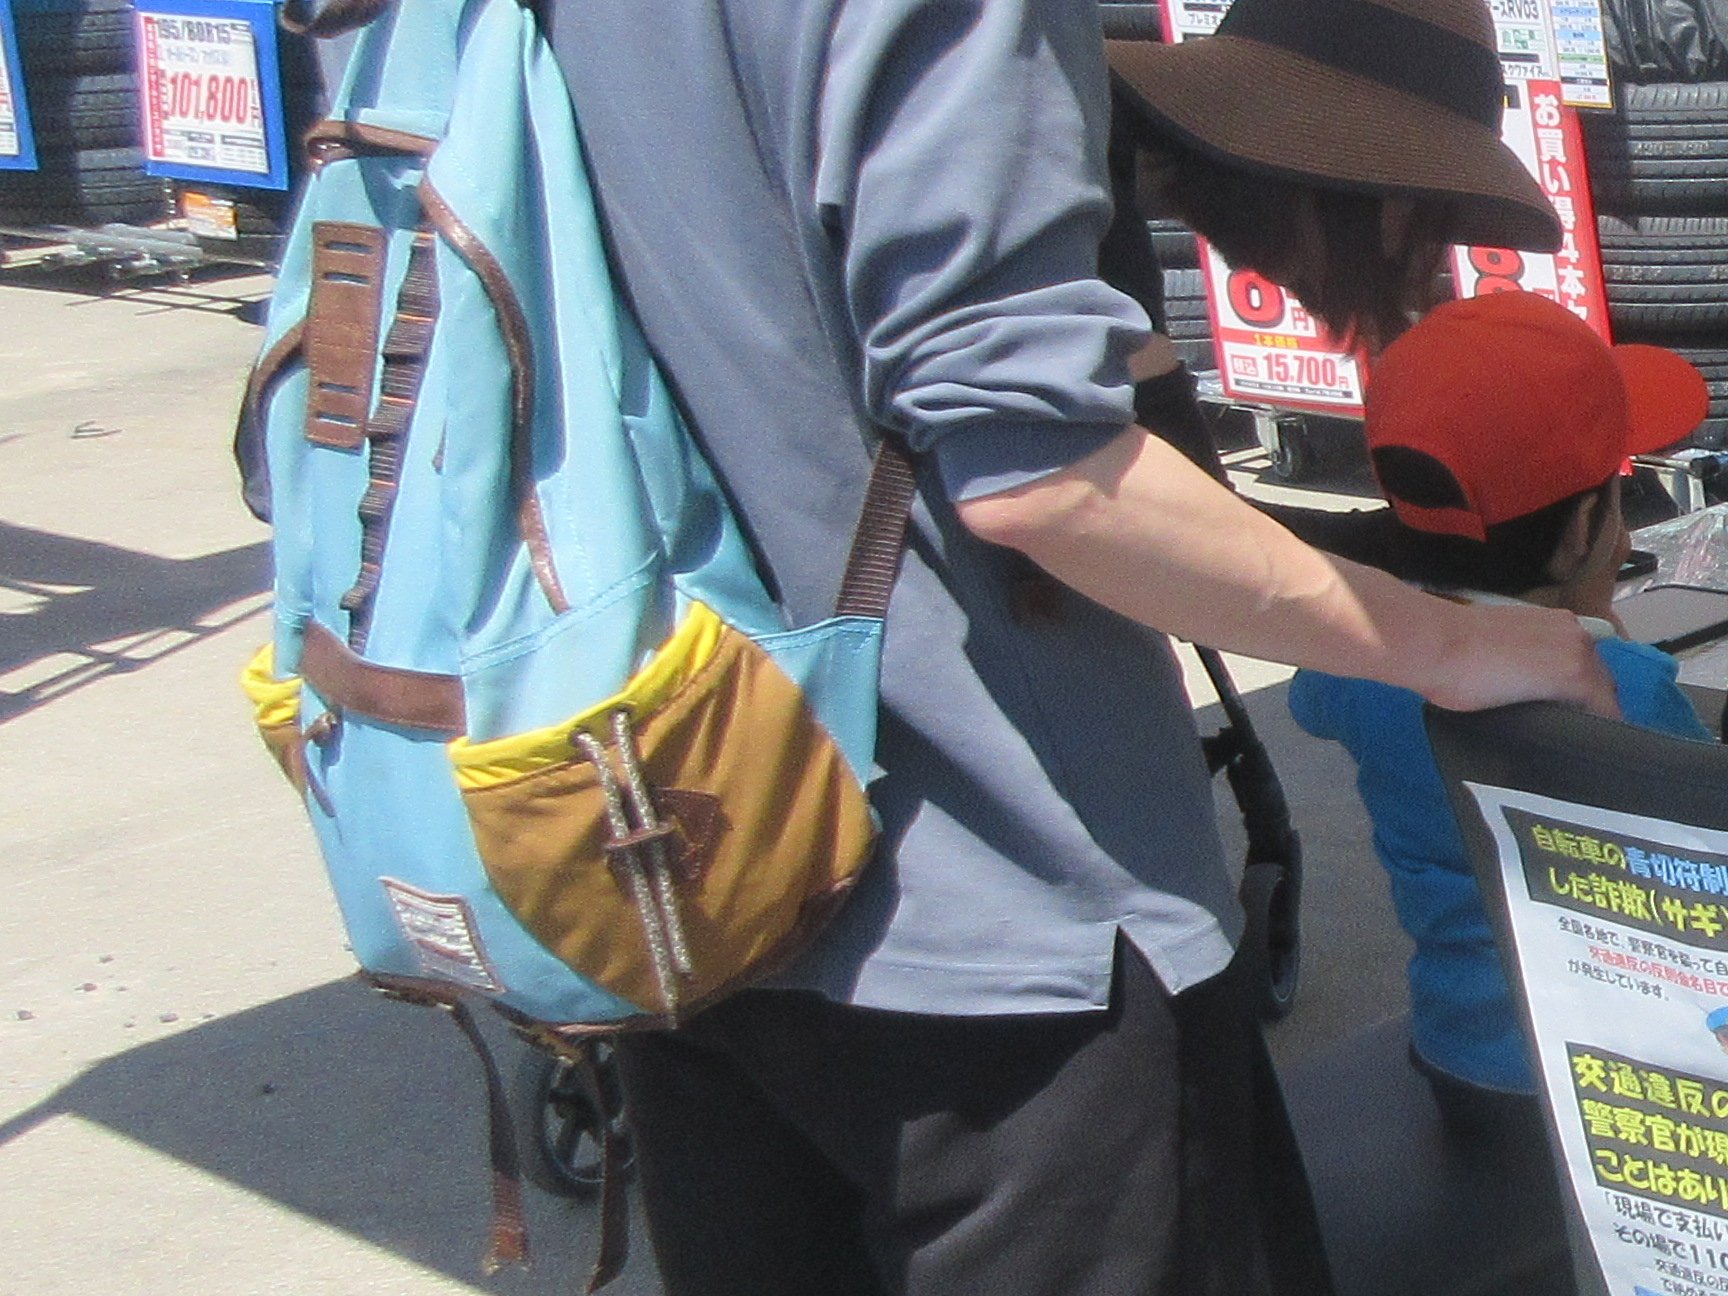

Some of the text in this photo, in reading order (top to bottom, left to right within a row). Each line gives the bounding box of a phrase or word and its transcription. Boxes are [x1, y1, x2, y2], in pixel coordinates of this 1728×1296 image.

[169, 70, 249, 125] 101,800
[1263, 353, 1337, 388] 15,700
[1567, 959, 1670, 1002] が発生しています。
